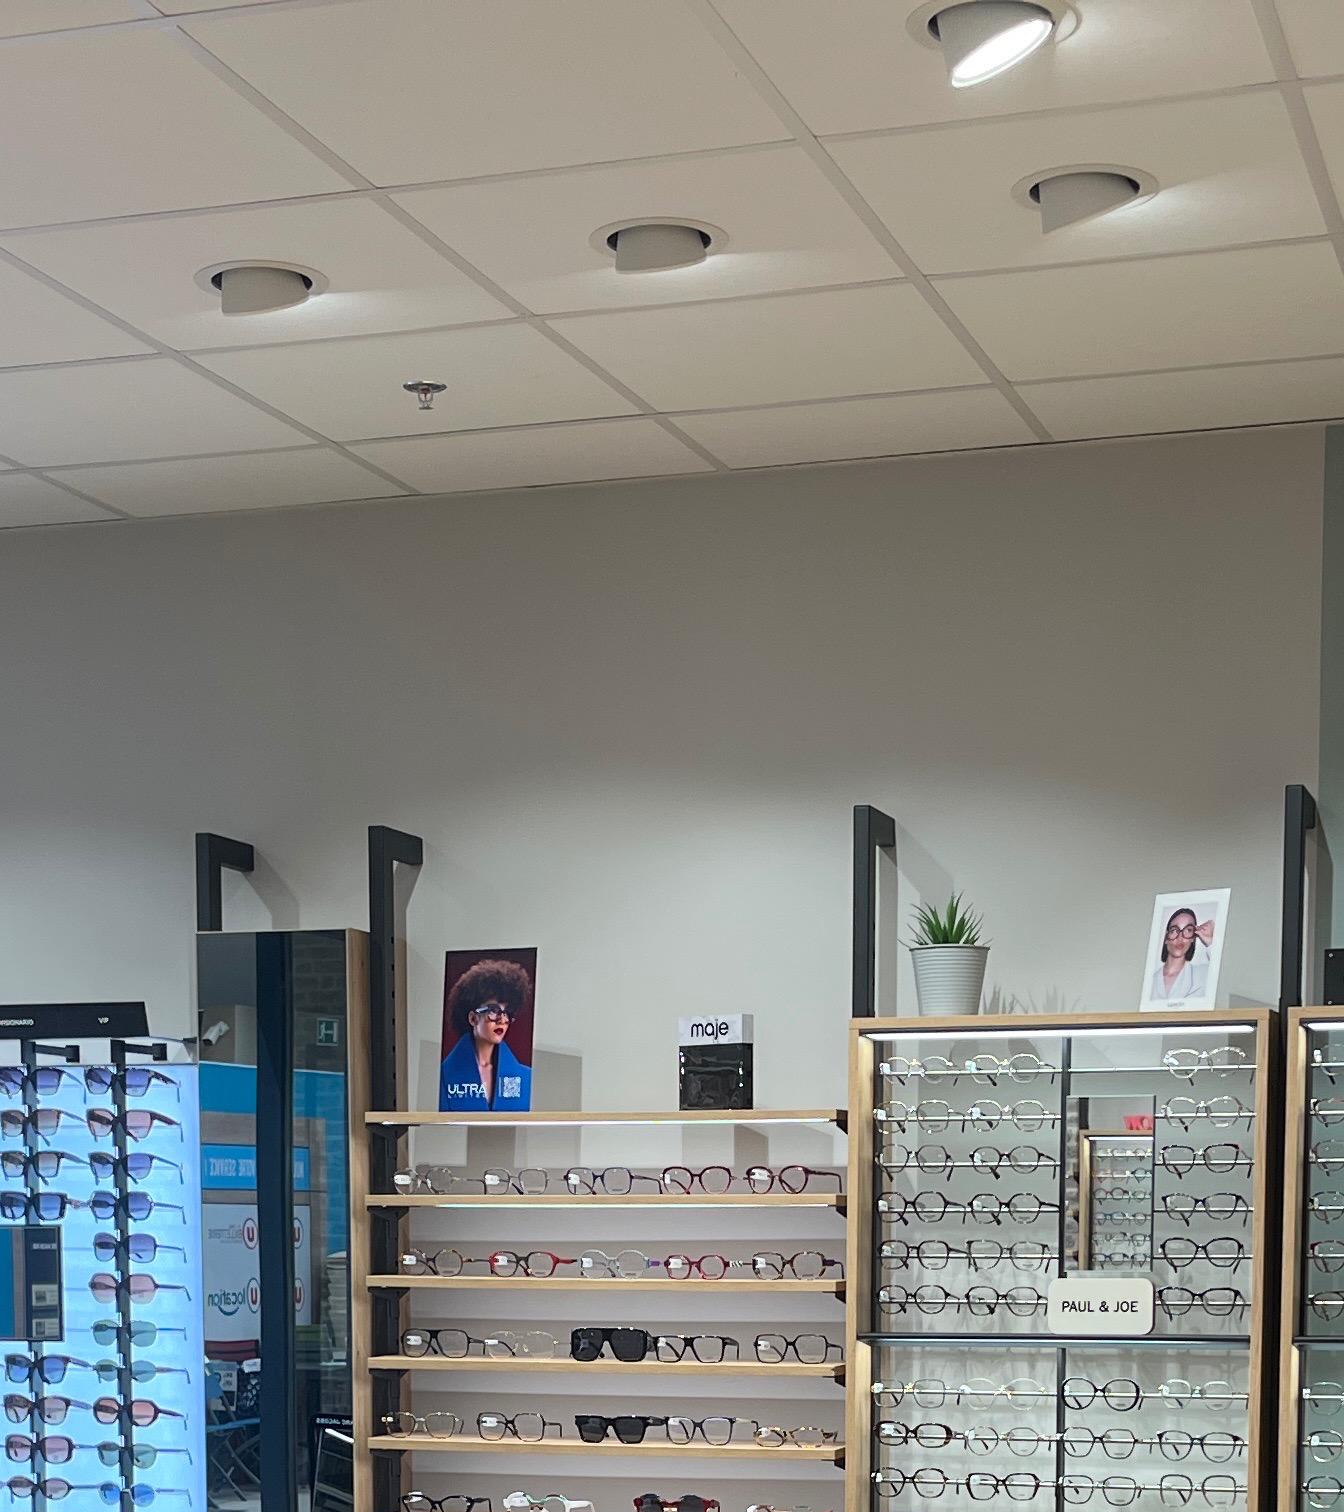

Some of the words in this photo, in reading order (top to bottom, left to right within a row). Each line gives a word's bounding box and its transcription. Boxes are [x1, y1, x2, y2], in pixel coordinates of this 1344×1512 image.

[691, 1019, 729, 1040] maje
[447, 1083, 487, 1094] ULTRA
[1061, 1300, 1094, 1312] PAUL
[1099, 1300, 1109, 1312] &
[1113, 1300, 1139, 1312] JOE
